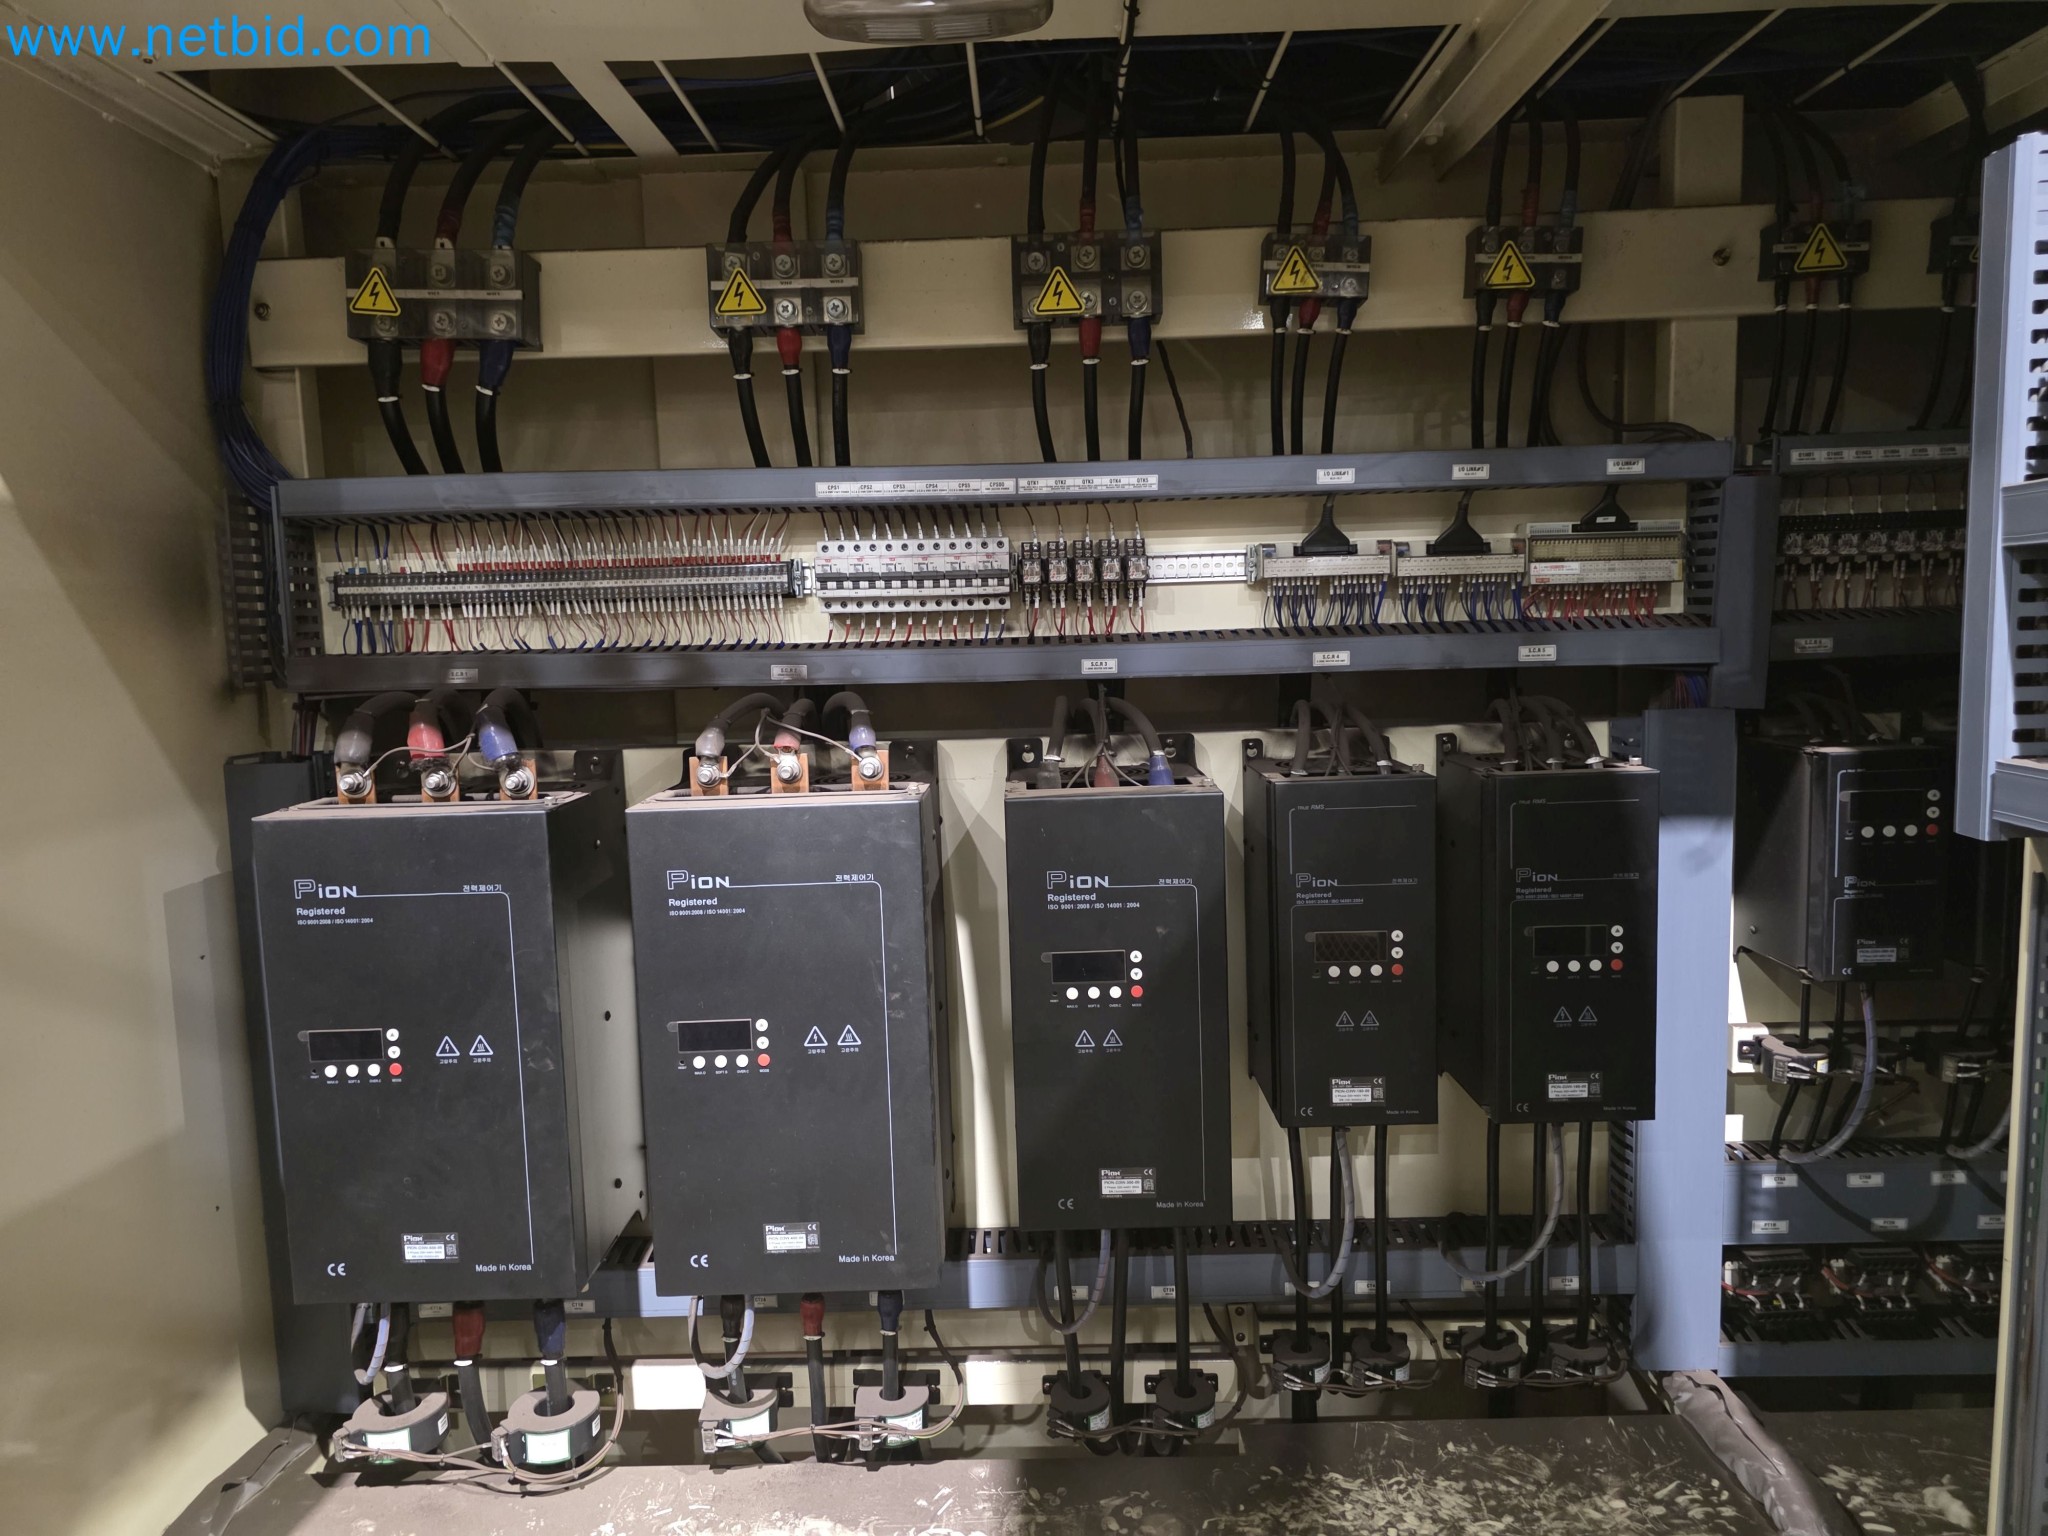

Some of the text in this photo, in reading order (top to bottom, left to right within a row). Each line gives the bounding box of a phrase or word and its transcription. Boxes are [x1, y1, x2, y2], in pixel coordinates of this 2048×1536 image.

[835, 873, 874, 882] 전력제어기
[462, 884, 502, 893] 전력제어기
[1047, 893, 1096, 903] Registered
[1296, 892, 1332, 900] Registered
[668, 897, 718, 907] Registered
[296, 907, 346, 917] Registered
[1842, 967, 1853, 975] CE
[1300, 1107, 1313, 1117] CE
[1516, 1103, 1529, 1112] CE
[1058, 1198, 1074, 1210] CE
[1156, 1201, 1175, 1209] Made
[1184, 1200, 1204, 1208] Korea
[690, 1254, 709, 1268] CE
[838, 1254, 895, 1263] Made in Korea
[327, 1263, 346, 1276] CE
[475, 1263, 532, 1272] Made in Korea
